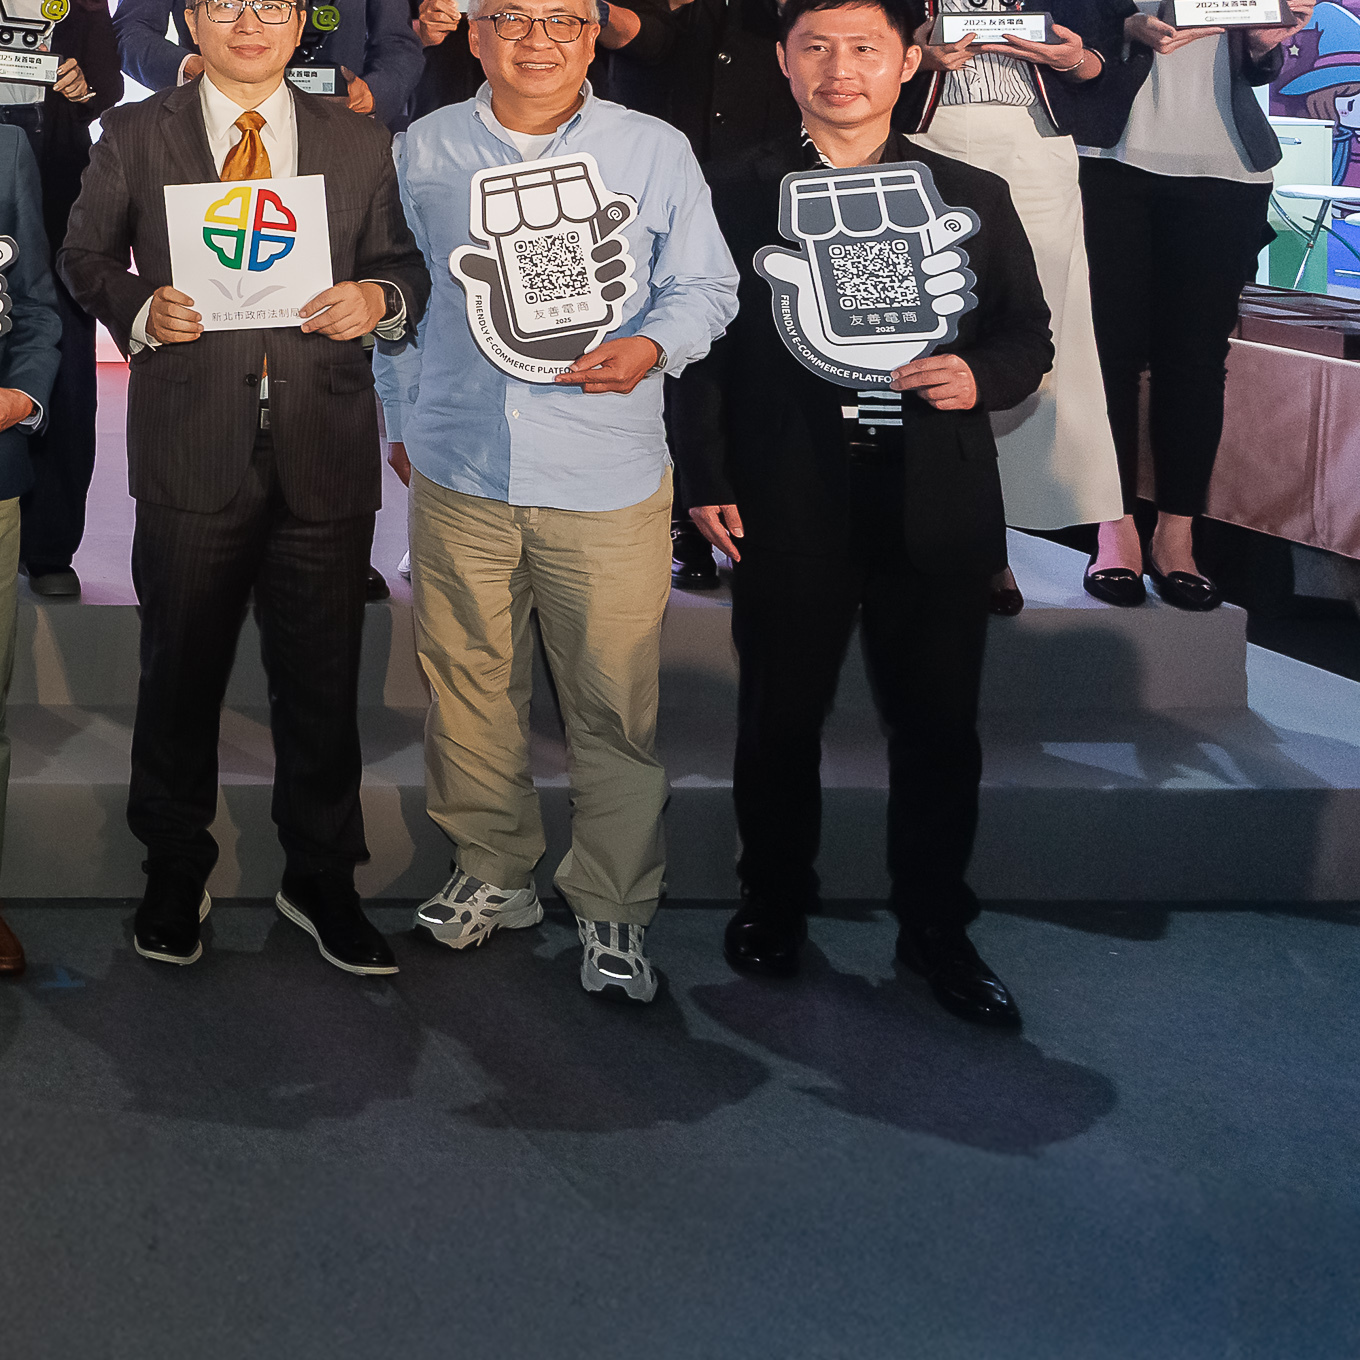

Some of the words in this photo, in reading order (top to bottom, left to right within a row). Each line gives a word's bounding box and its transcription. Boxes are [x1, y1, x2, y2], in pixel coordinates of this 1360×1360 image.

[211, 307, 300, 322] 新北市政府法制局
[533, 302, 590, 321] 友善電商
[849, 310, 918, 326] 友善電商
[555, 317, 573, 325] 2025
[474, 294, 491, 336] FRIENDLY
[485, 335, 536, 373] E-COMMERCE
[780, 293, 798, 338] FRIENDLY
[791, 336, 850, 379] E-COMMERCE
[875, 326, 896, 334] 2025
